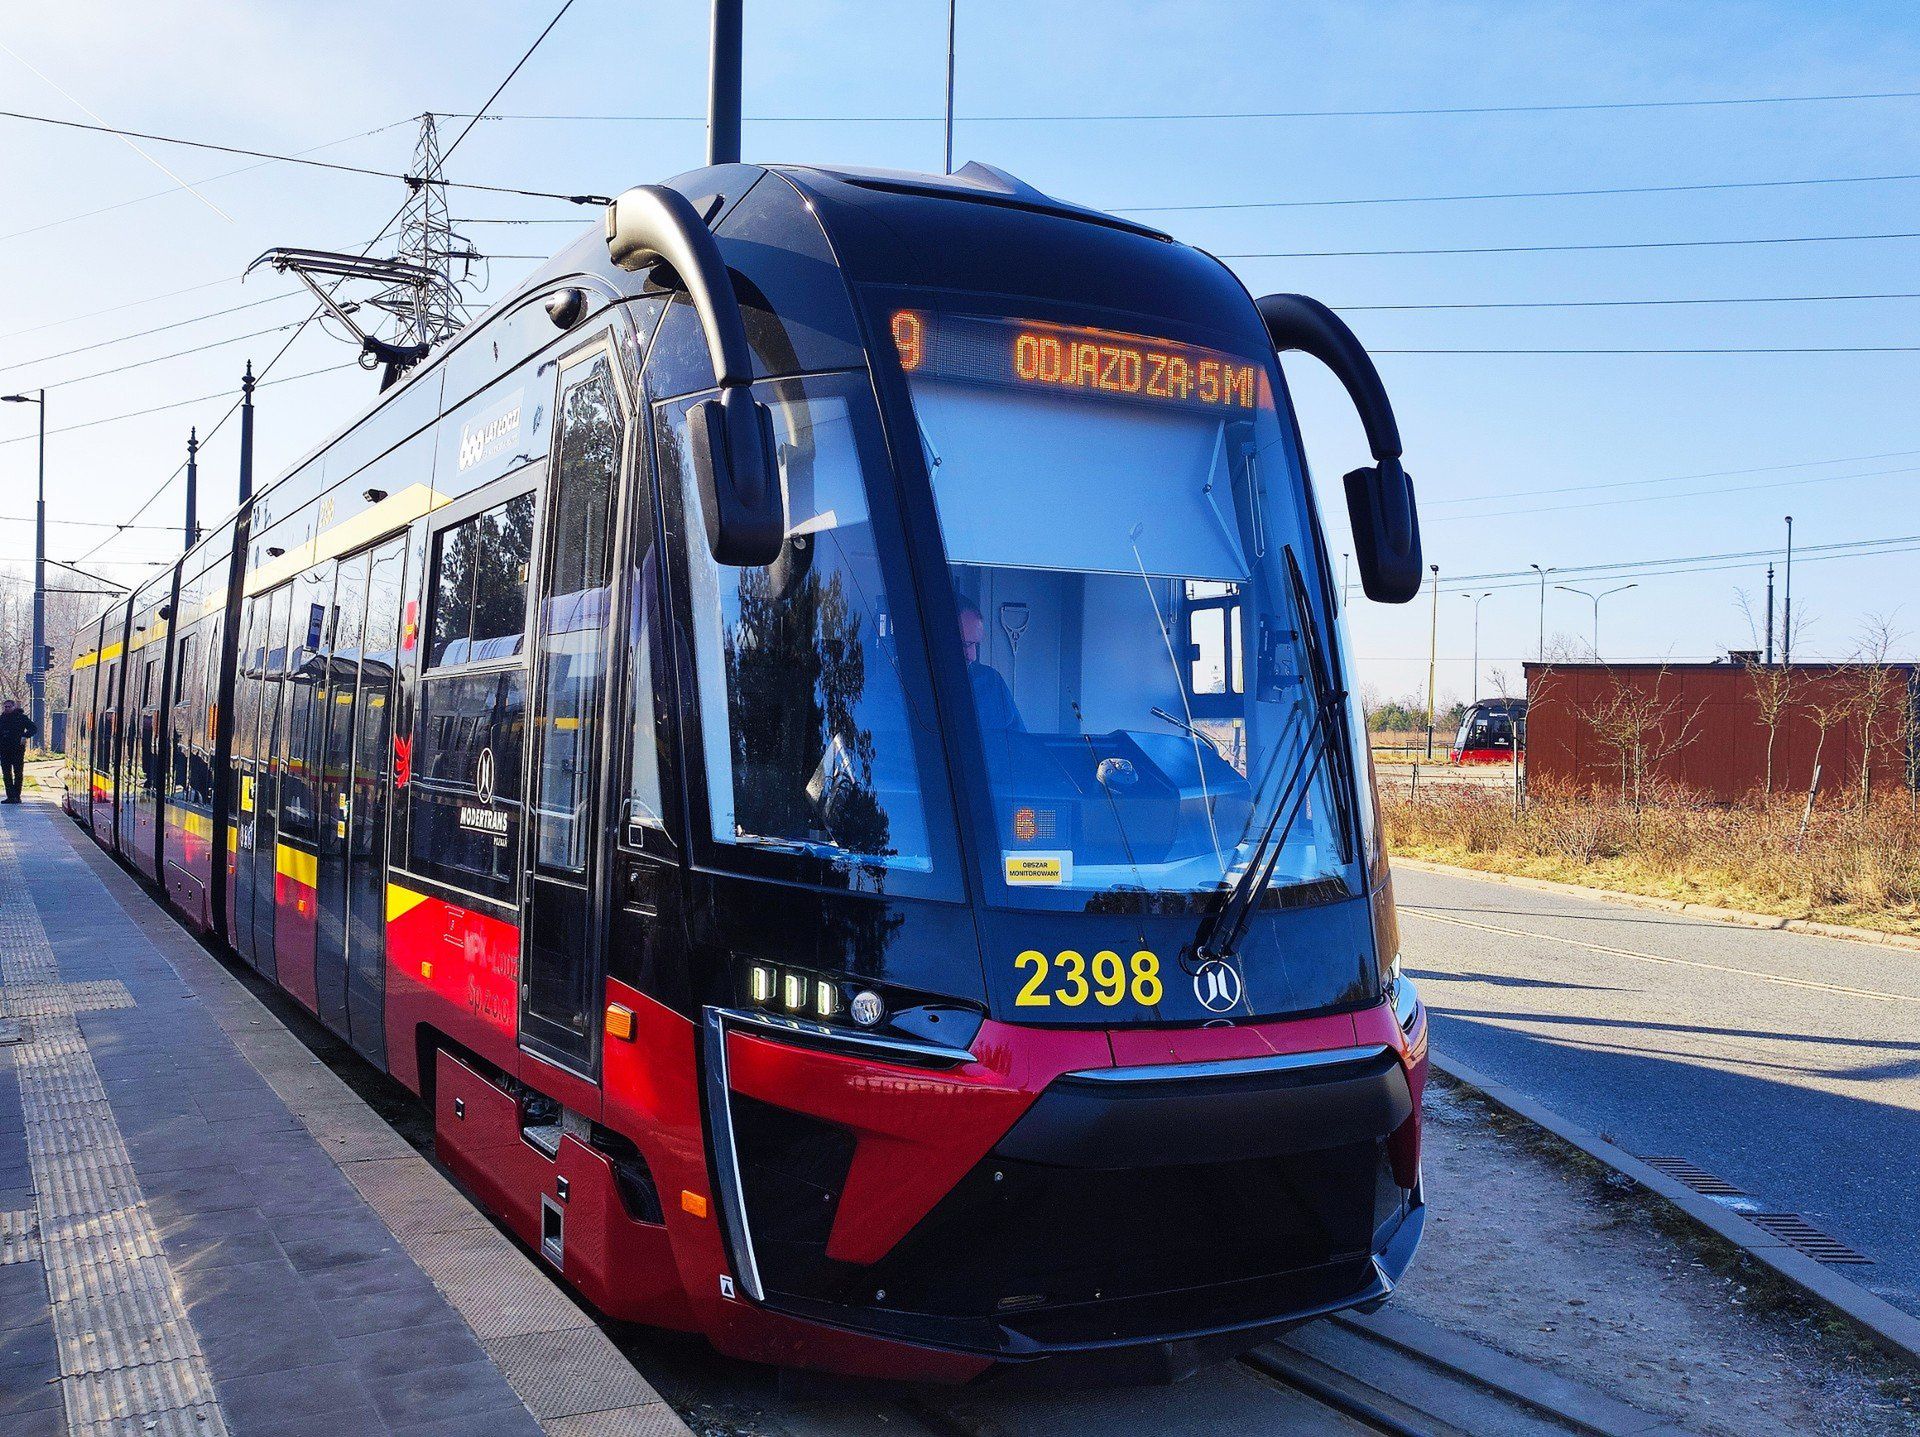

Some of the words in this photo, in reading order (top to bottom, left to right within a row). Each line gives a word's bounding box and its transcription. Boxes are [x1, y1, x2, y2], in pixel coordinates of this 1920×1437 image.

[892, 312, 920, 371] 9
[1016, 334, 1141, 393] ODJAZD
[1199, 361, 1219, 403] 5
[460, 807, 508, 832] MODERTRANS
[1016, 808, 1037, 840] 6
[1009, 870, 1060, 878] MONITOROWANY
[1022, 861, 1048, 869] OBSZAR
[1014, 950, 1164, 1007] 2398
